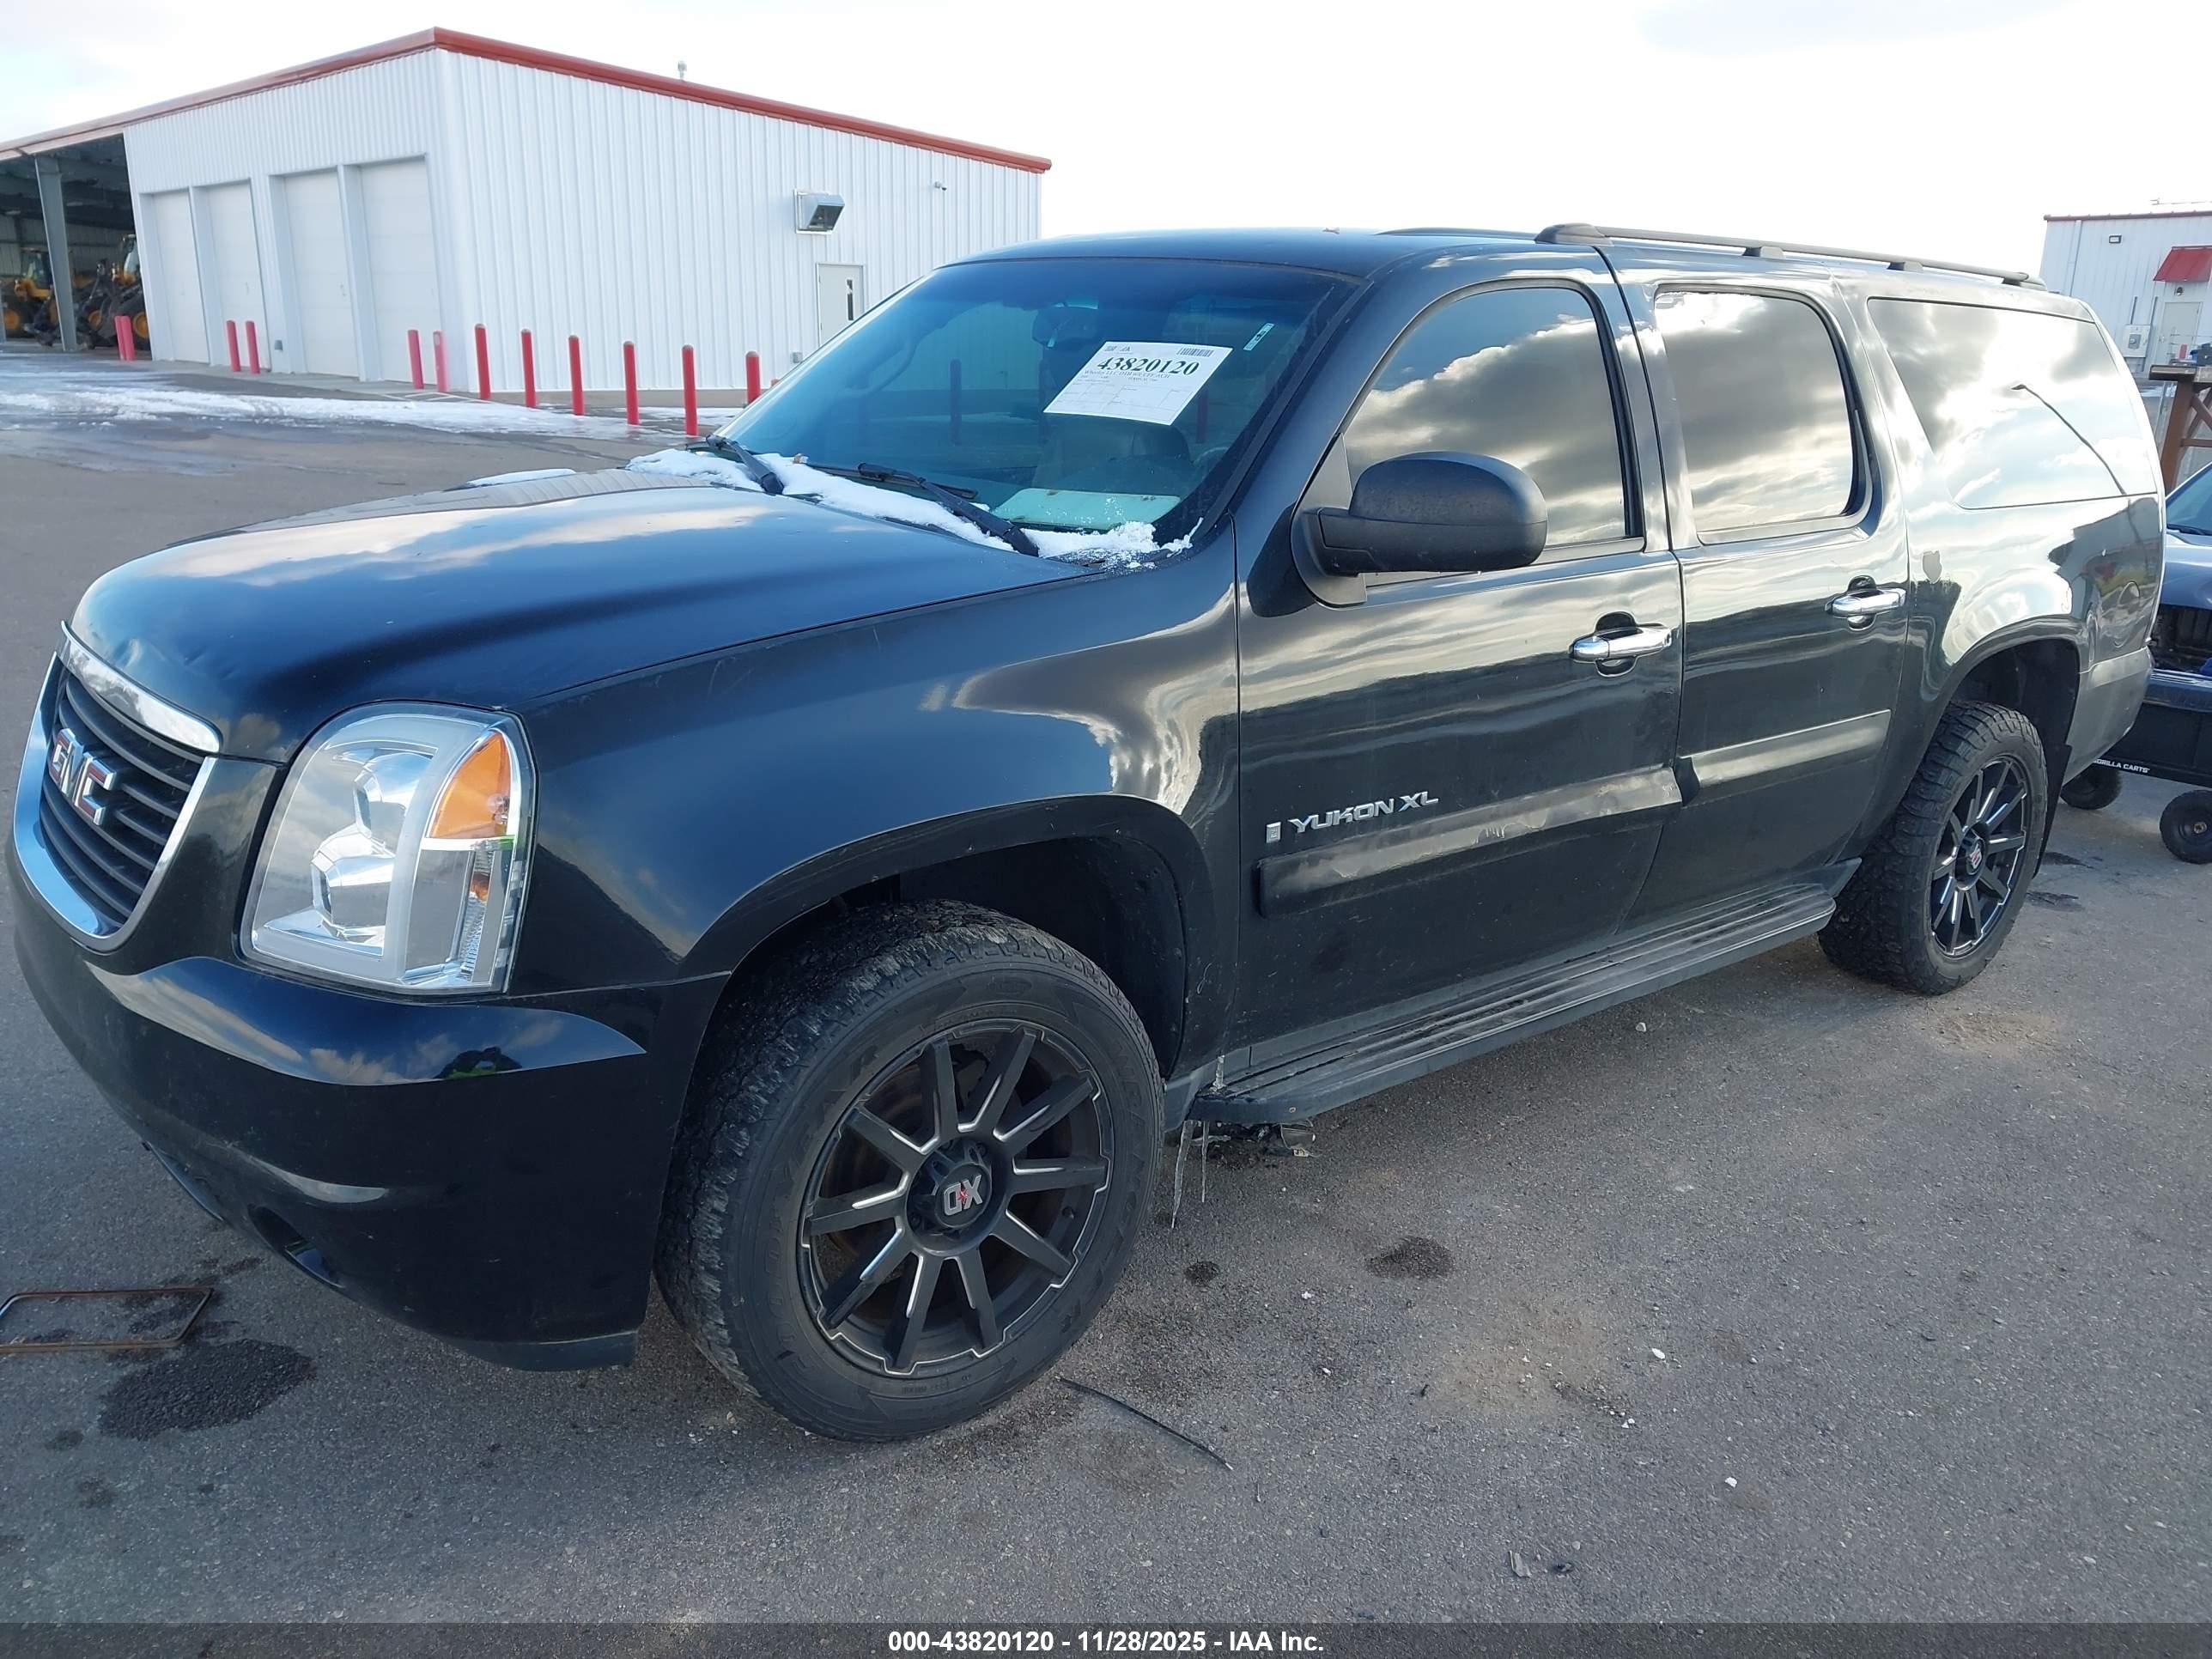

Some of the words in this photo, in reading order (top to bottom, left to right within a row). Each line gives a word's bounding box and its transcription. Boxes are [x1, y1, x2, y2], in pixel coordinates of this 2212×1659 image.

[1097, 356, 1200, 375] 43820120
[49, 727, 117, 825] GMC
[2094, 758, 2122, 769] ORILLA
[1288, 797, 1395, 834] YUKON
[1398, 791, 1439, 812] XL
